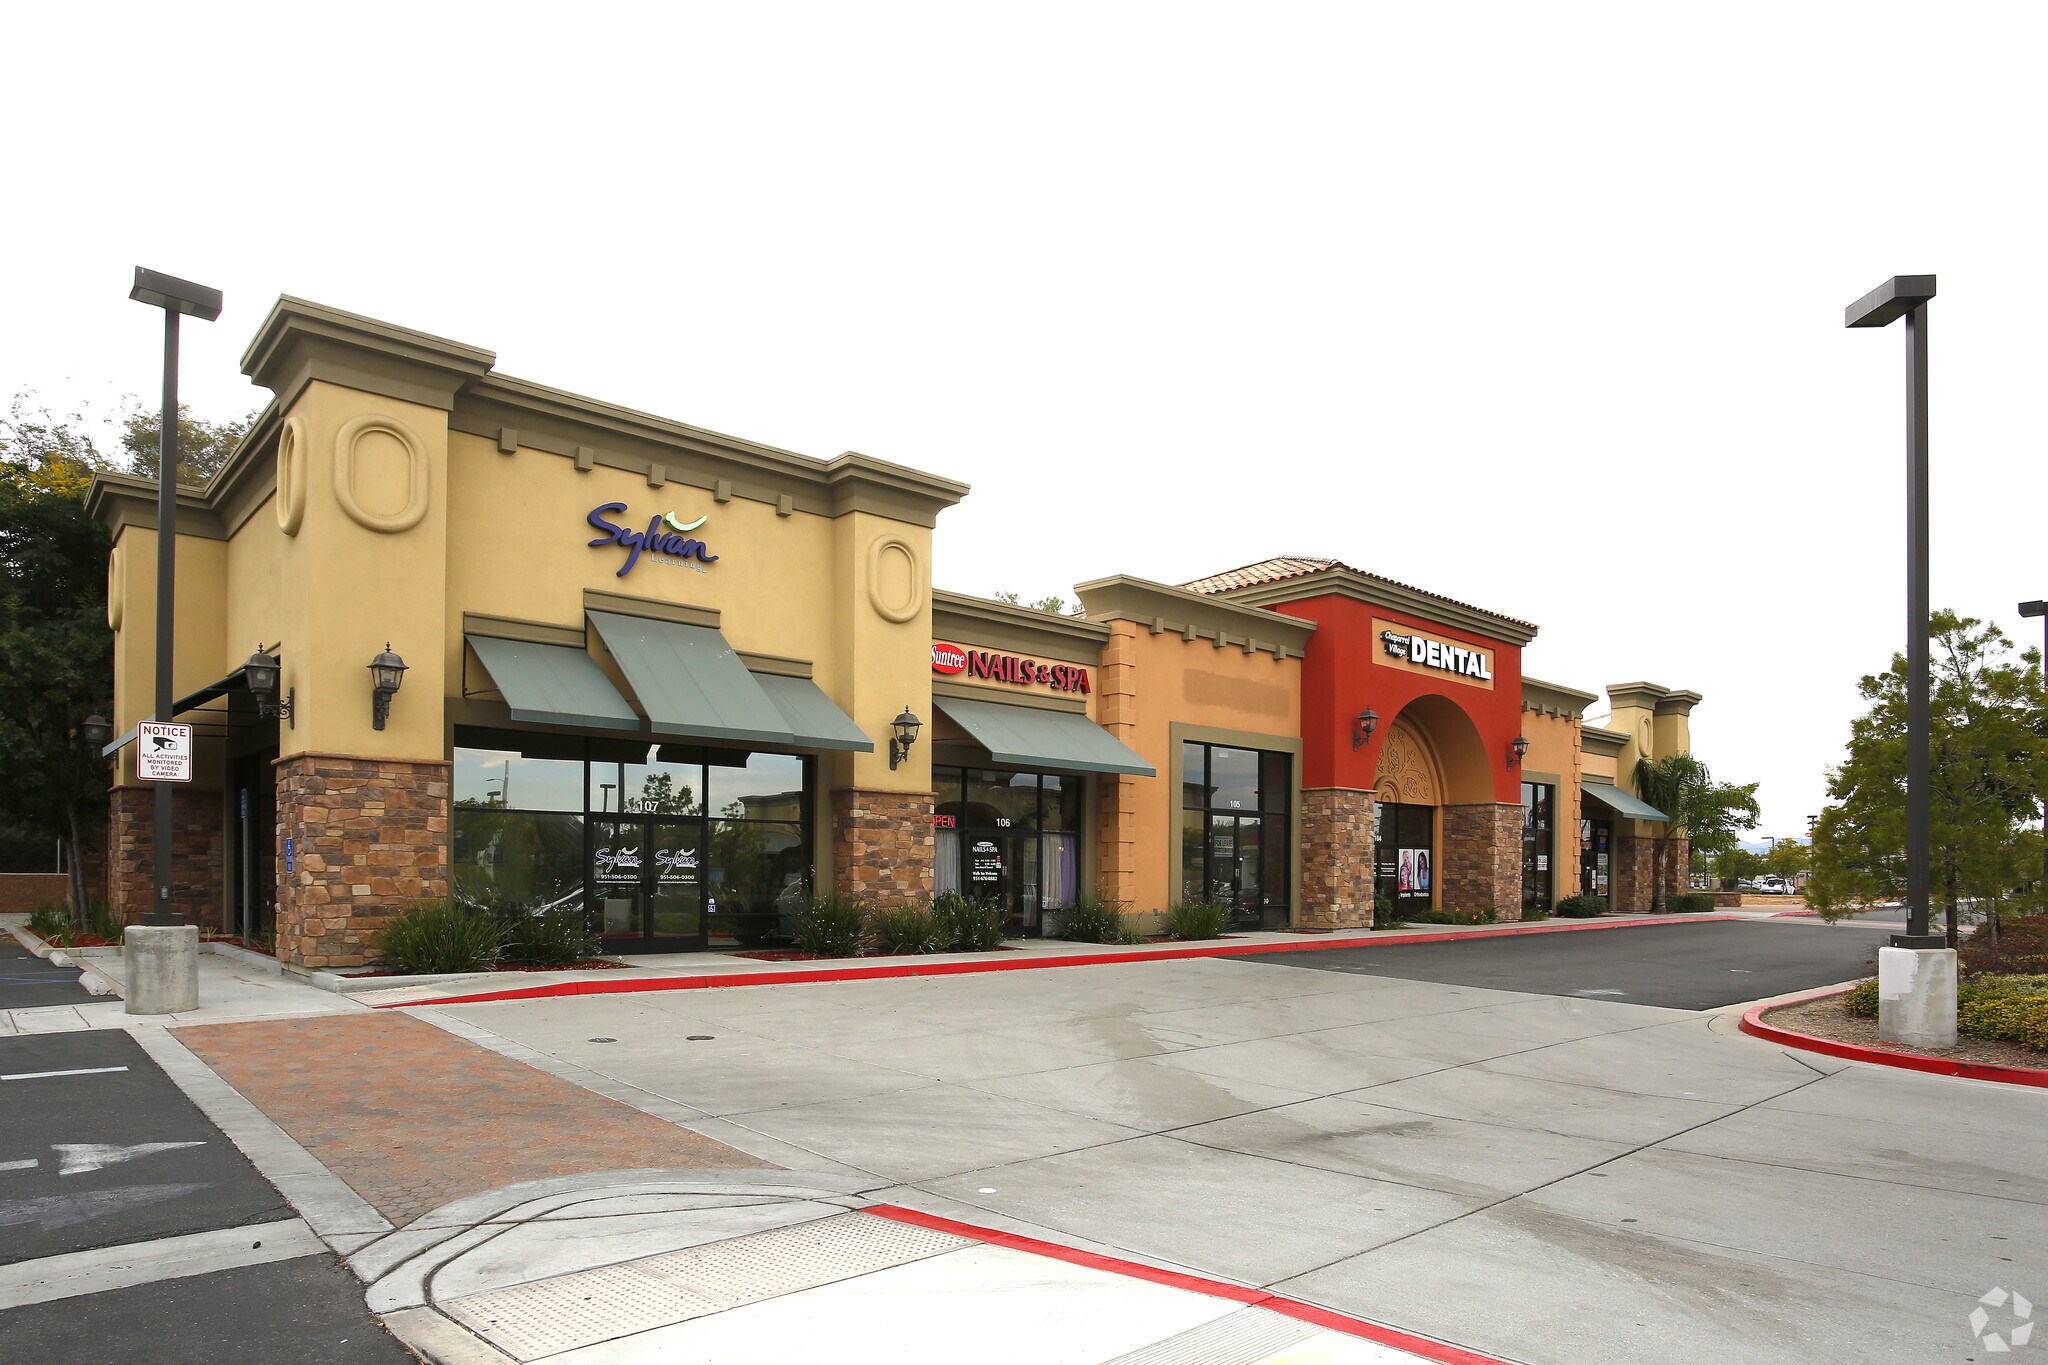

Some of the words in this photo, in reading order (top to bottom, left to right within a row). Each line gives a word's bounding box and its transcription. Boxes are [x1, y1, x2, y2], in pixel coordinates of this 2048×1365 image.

[587, 502, 719, 577] Sylvan
[651, 553, 703, 572] Learning
[932, 645, 965, 669] Suntree
[1388, 643, 1407, 657] Village
[1409, 635, 1492, 680] DENTAL
[968, 650, 1036, 685] NAILS
[1036, 665, 1051, 683] &
[1051, 664, 1091, 694] SPA
[144, 726, 187, 737] NOTICE
[638, 800, 659, 811] 107
[1230, 800, 1241, 808] 105
[934, 816, 955, 828] PEN
[996, 818, 1011, 827] 106
[595, 847, 642, 873] Sylvan
[655, 849, 699, 873] Sylvan
